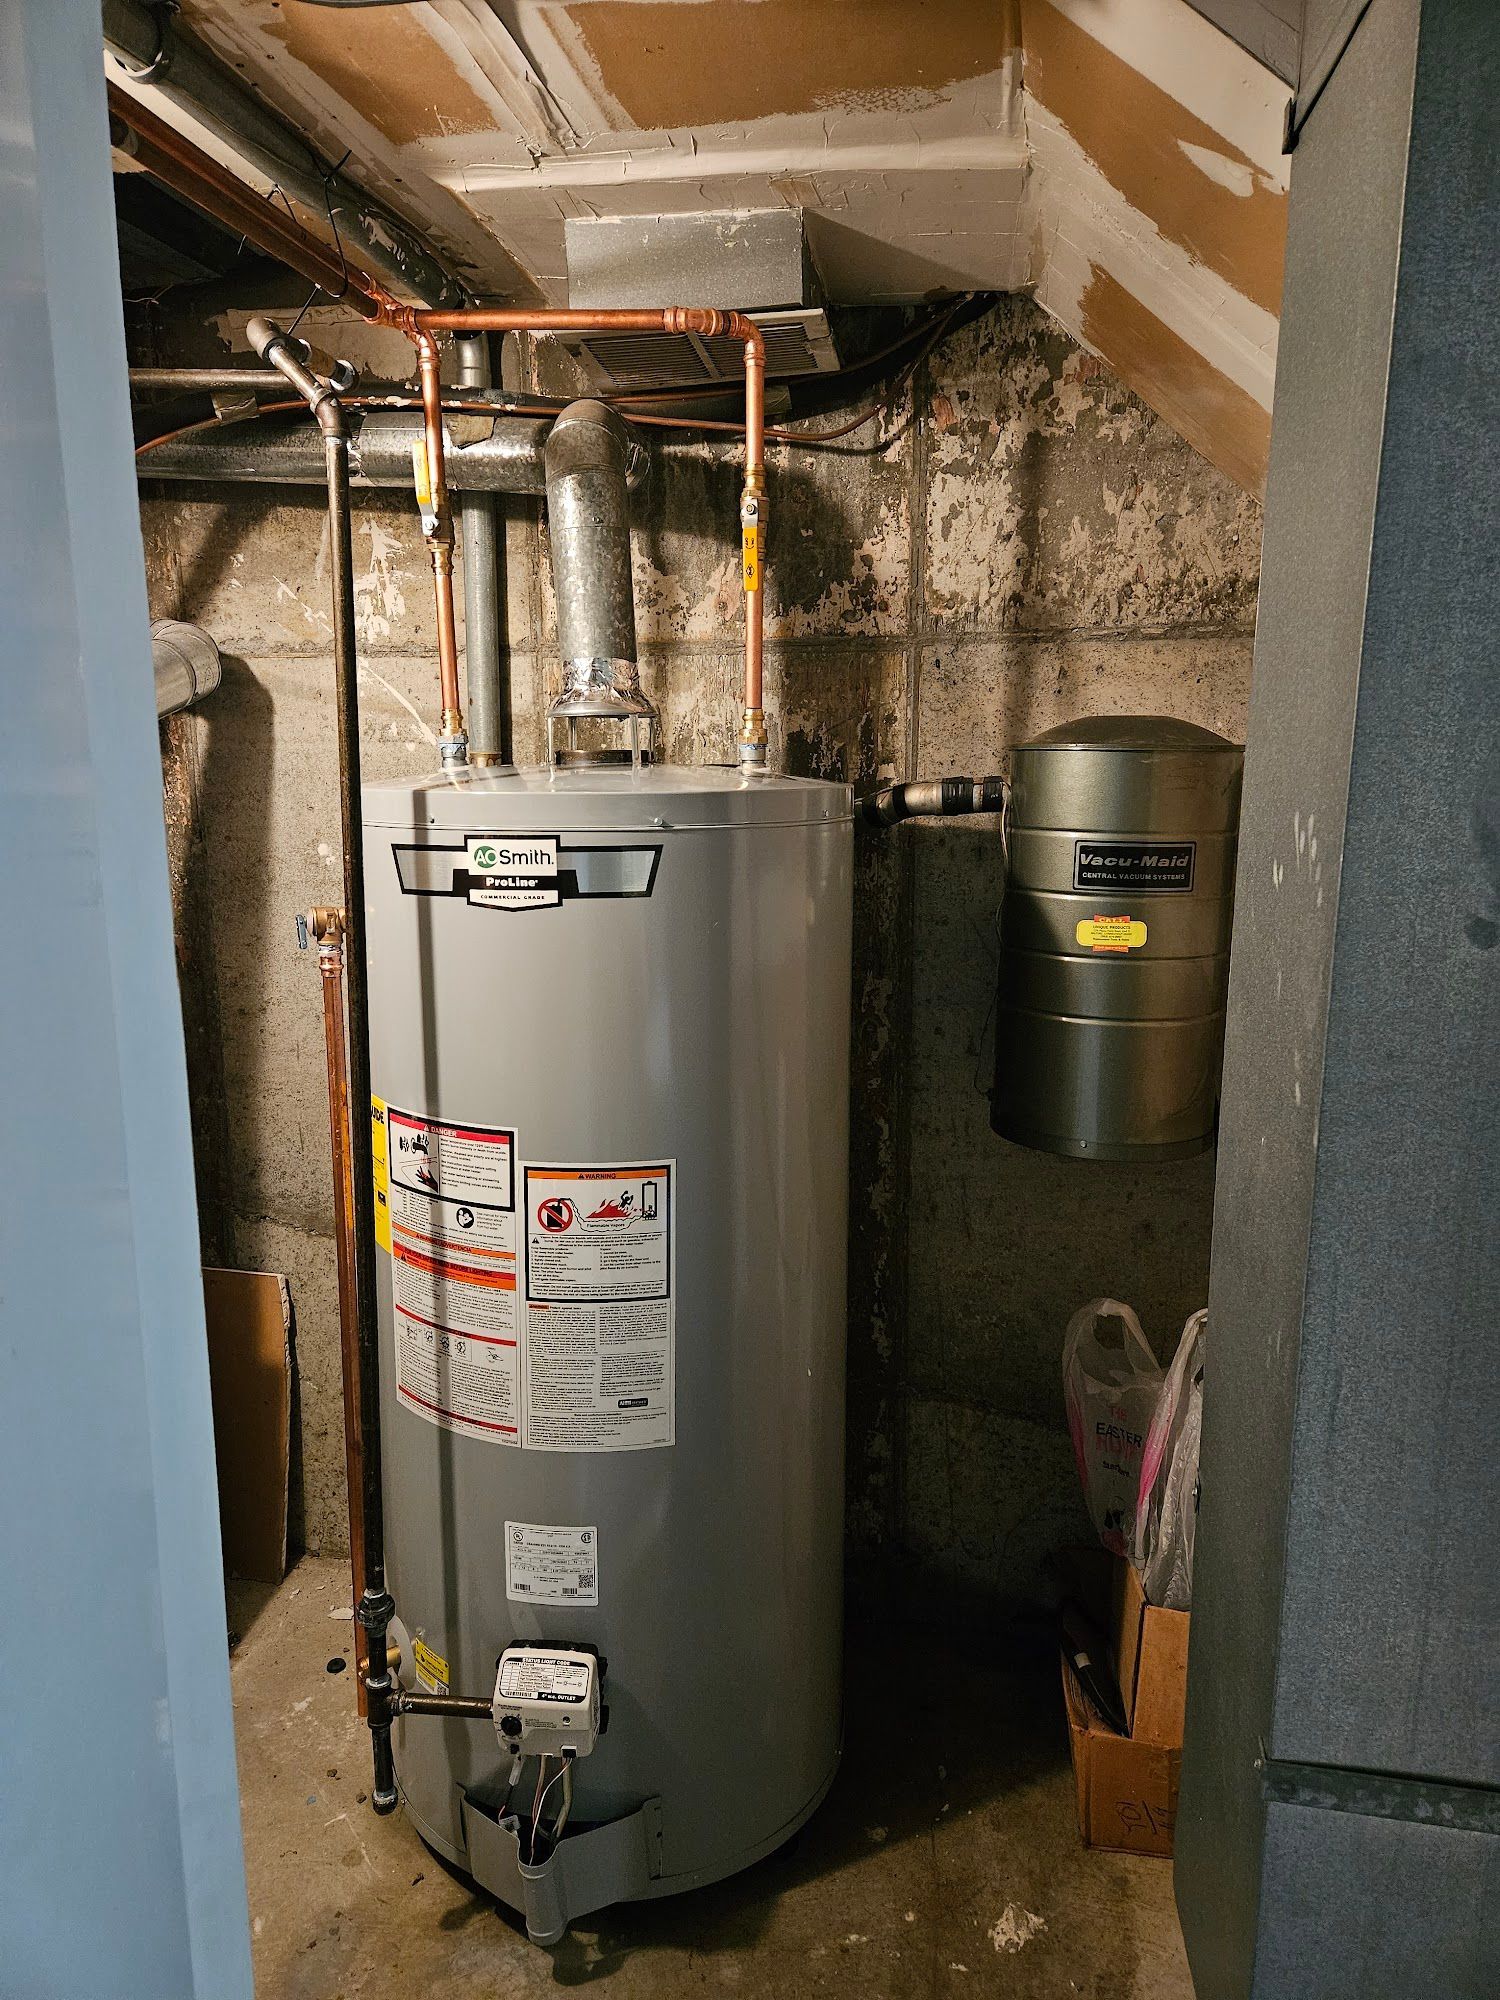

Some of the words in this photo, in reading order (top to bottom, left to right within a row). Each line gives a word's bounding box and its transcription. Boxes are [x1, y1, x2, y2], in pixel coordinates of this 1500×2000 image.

[475, 848, 497, 865] AO
[1080, 853, 1188, 867] Vacu-Maid
[486, 876, 538, 887] ProLine
[431, 1127, 457, 1137] DANGER
[1096, 1422, 1142, 1448] EASTER
